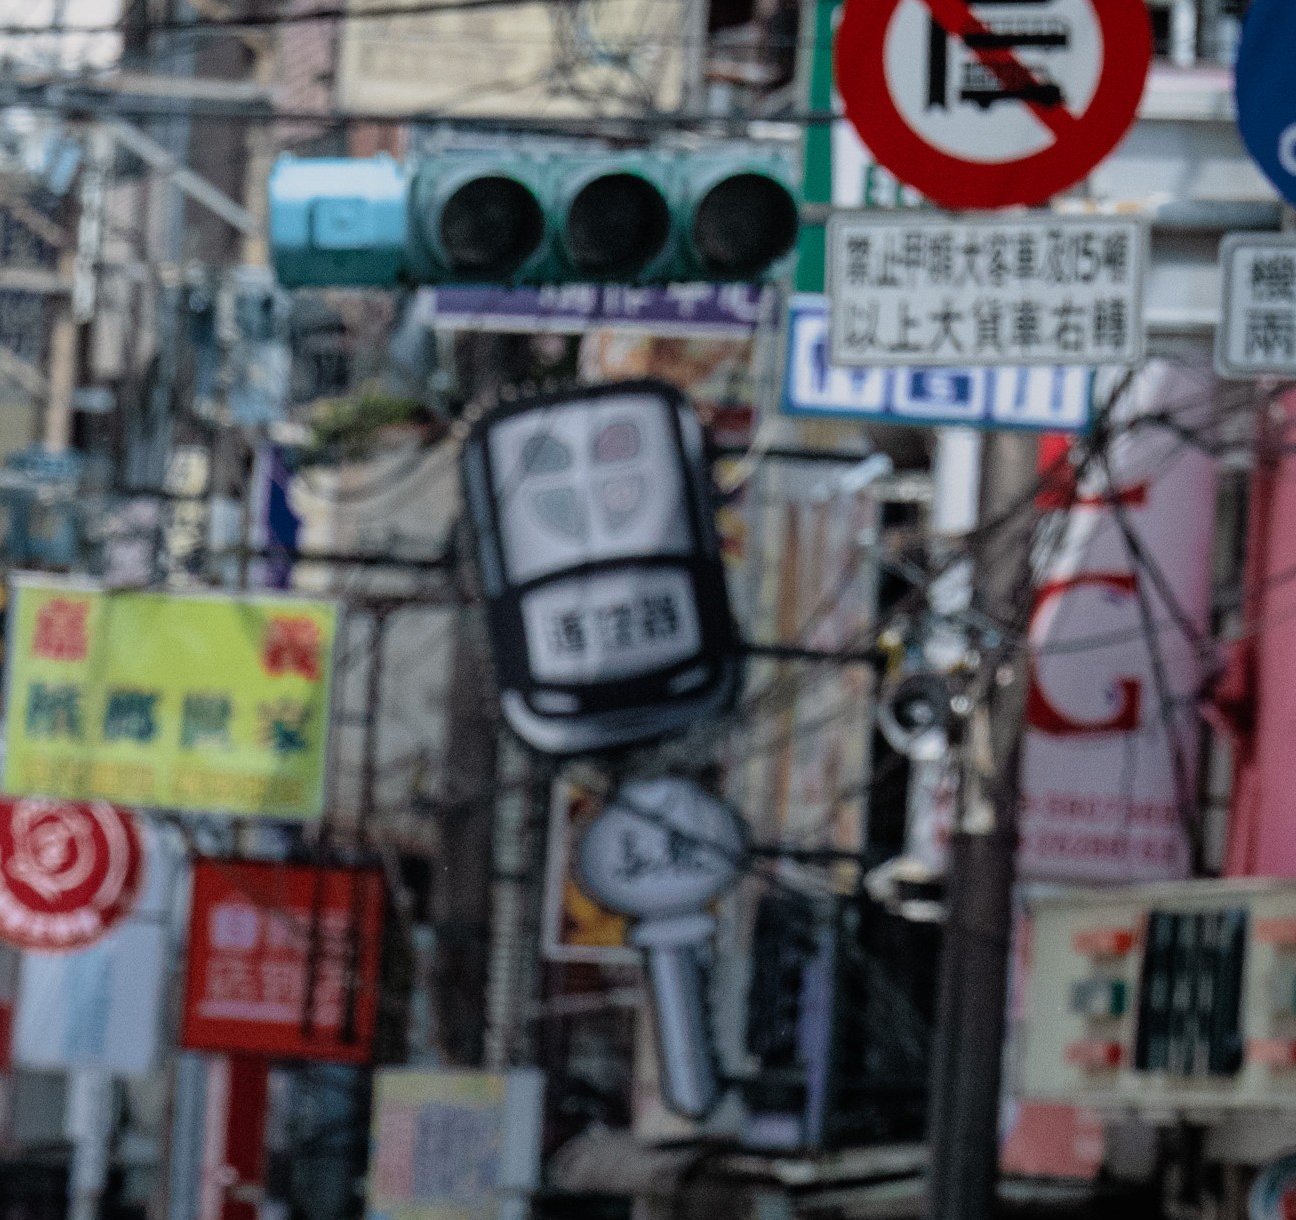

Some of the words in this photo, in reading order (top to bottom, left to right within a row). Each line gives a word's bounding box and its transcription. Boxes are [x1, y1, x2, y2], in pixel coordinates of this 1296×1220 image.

[843, 298, 1129, 359] 以上大貨車右轉
